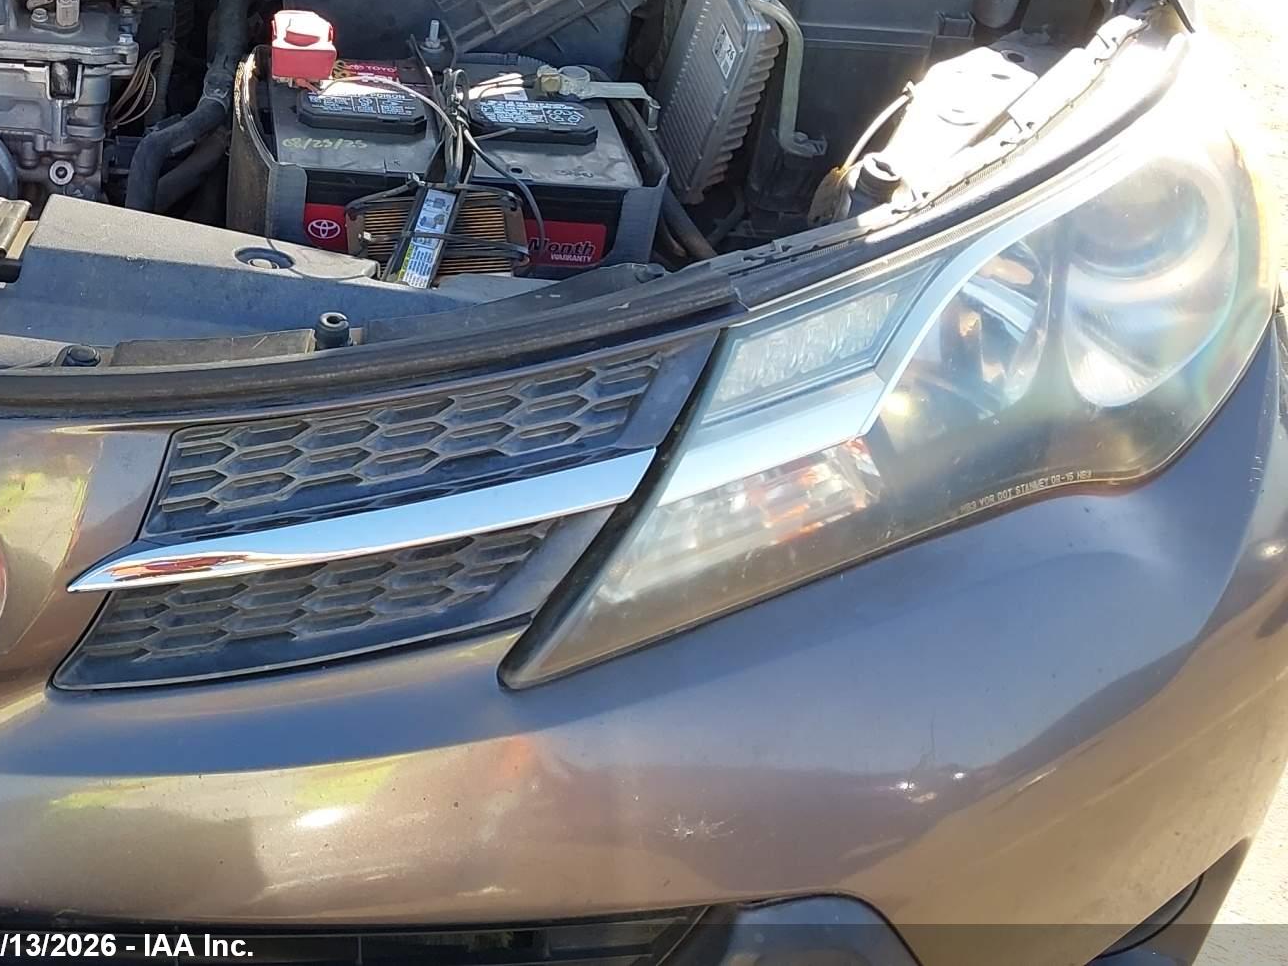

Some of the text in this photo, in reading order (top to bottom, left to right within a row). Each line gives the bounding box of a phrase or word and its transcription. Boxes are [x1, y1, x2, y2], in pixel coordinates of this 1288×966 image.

[550, 253, 593, 263] WARRANTY
[997, 488, 1013, 502] DOT
[1015, 477, 1049, 494] STANLEY
